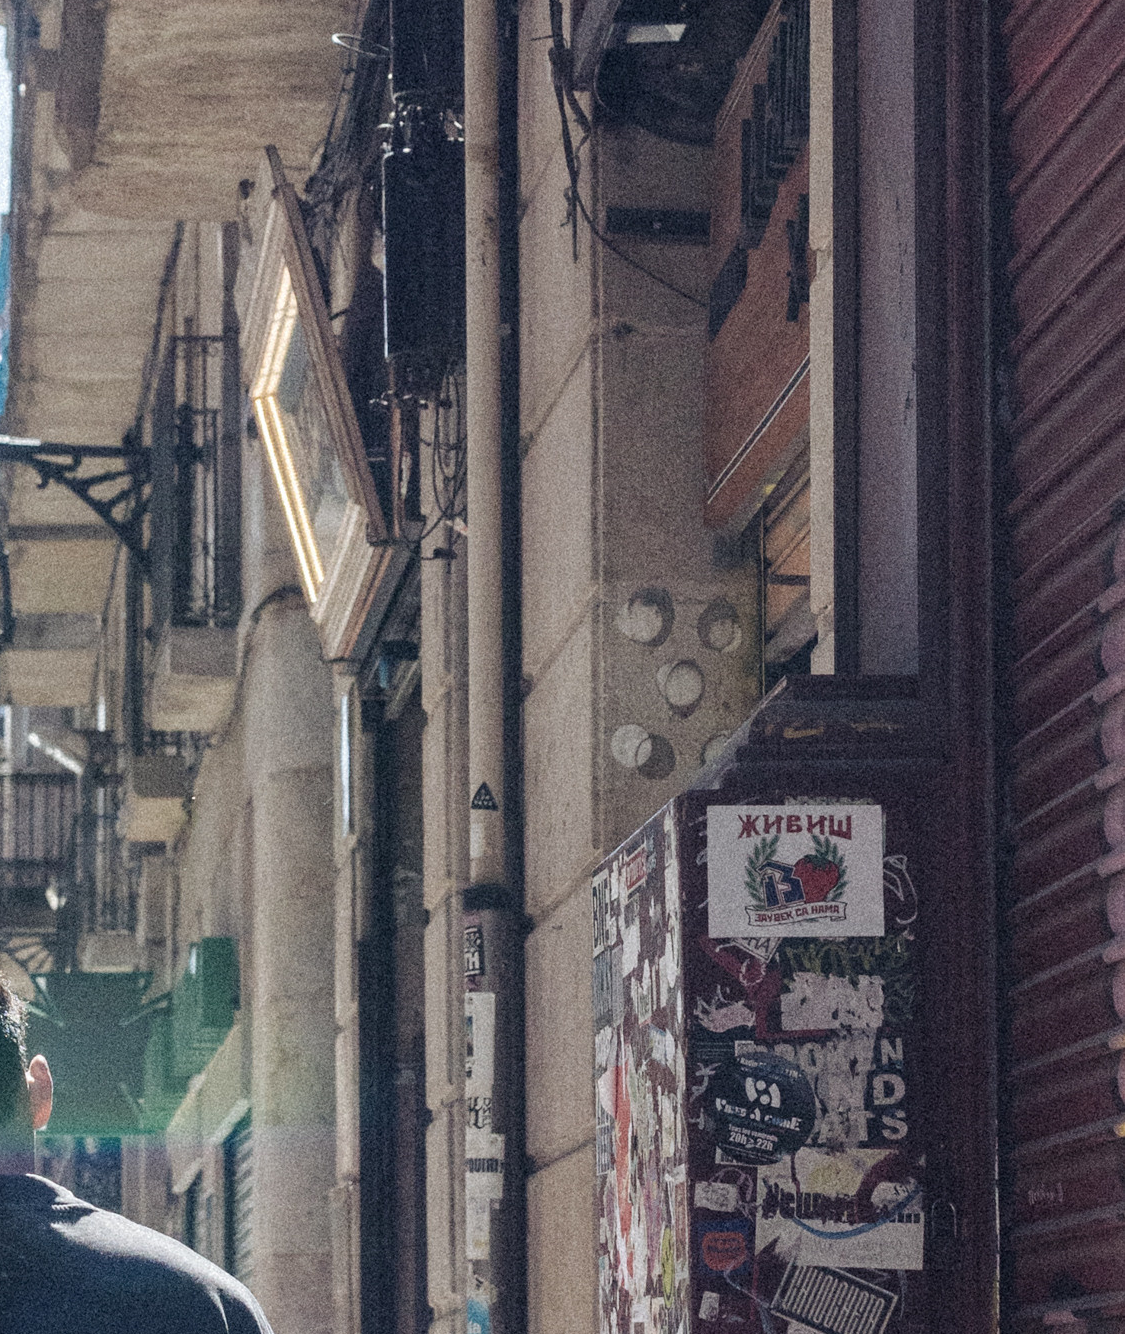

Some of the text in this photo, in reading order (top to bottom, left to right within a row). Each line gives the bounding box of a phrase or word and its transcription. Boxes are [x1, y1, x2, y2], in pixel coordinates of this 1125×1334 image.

[738, 814, 852, 840] ЖИВИШ
[811, 905, 840, 915] НАМА
[729, 1132, 774, 1151] 20h 22h
